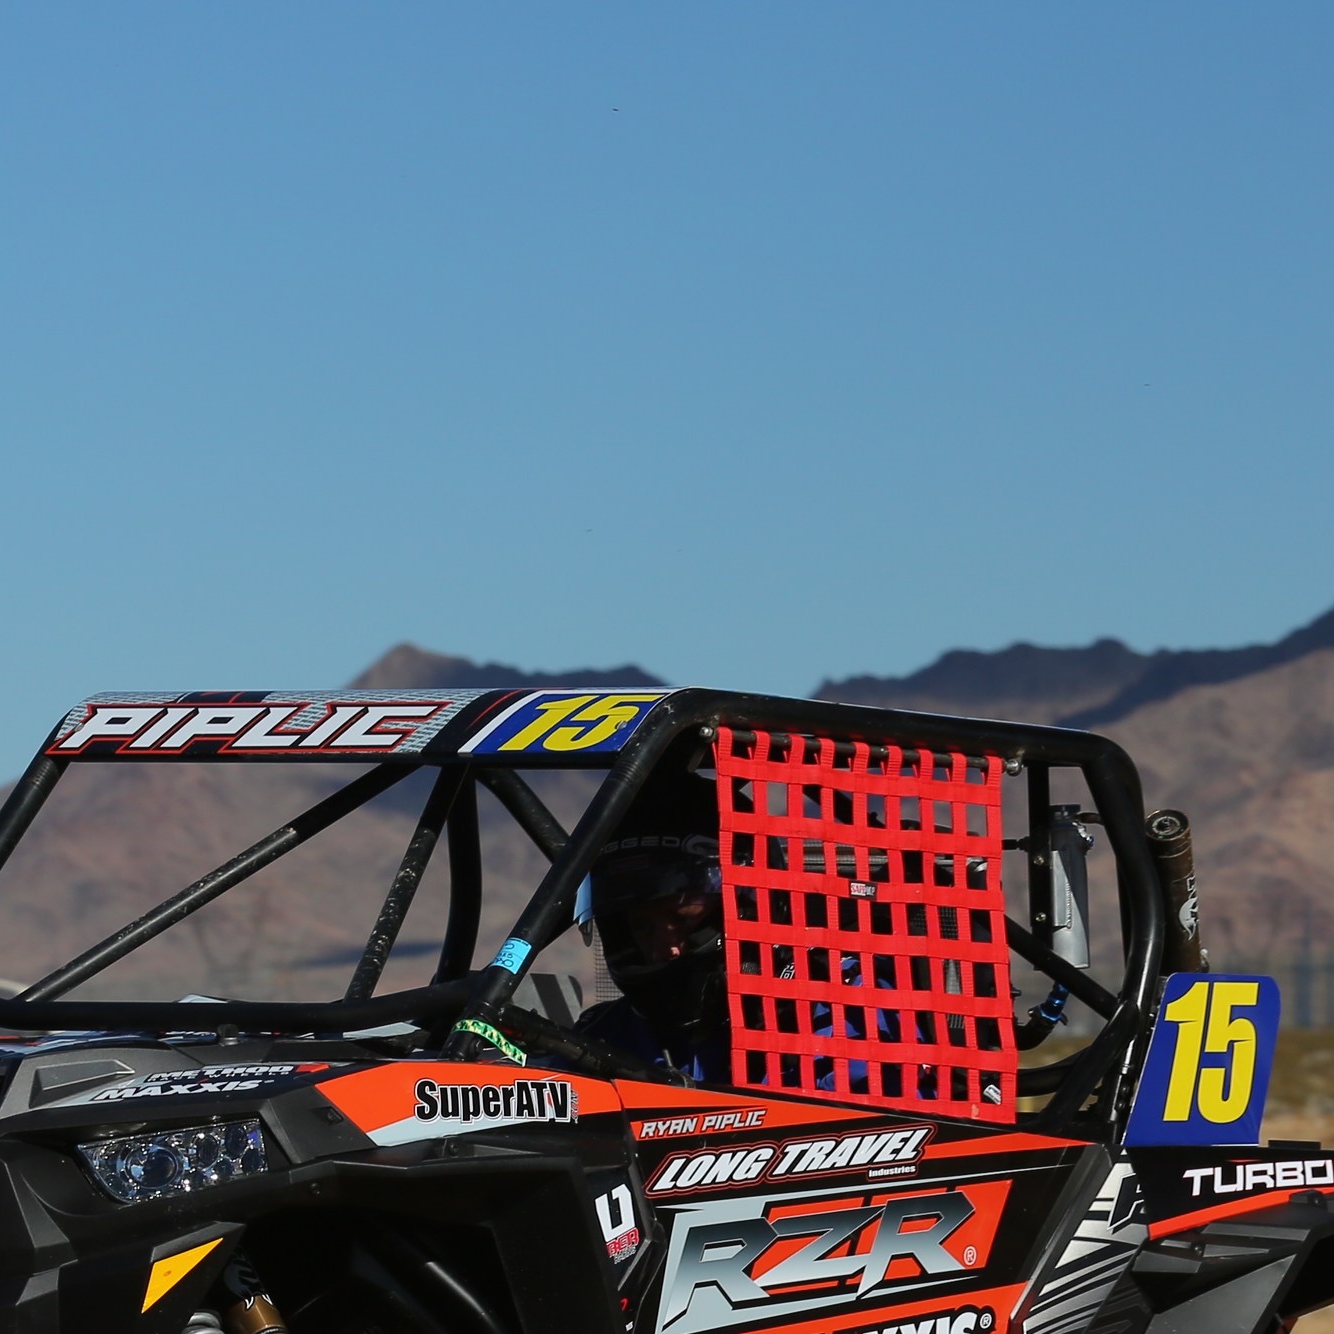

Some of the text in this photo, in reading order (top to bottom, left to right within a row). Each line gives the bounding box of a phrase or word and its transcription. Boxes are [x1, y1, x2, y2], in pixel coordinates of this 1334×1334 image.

[59, 705, 440, 748] PIPLIC
[498, 694, 663, 752] 15
[149, 1063, 295, 1081] METHOD
[1162, 981, 1259, 1124] 15
[93, 1079, 264, 1101] MAXXIS
[414, 1078, 571, 1123] SuperATV
[640, 1110, 767, 1139] RYAN PIPLIC
[651, 1128, 931, 1192] LONG TRAVEL
[1182, 1159, 1334, 1197] TURBO
[661, 1190, 976, 1333] RZR
